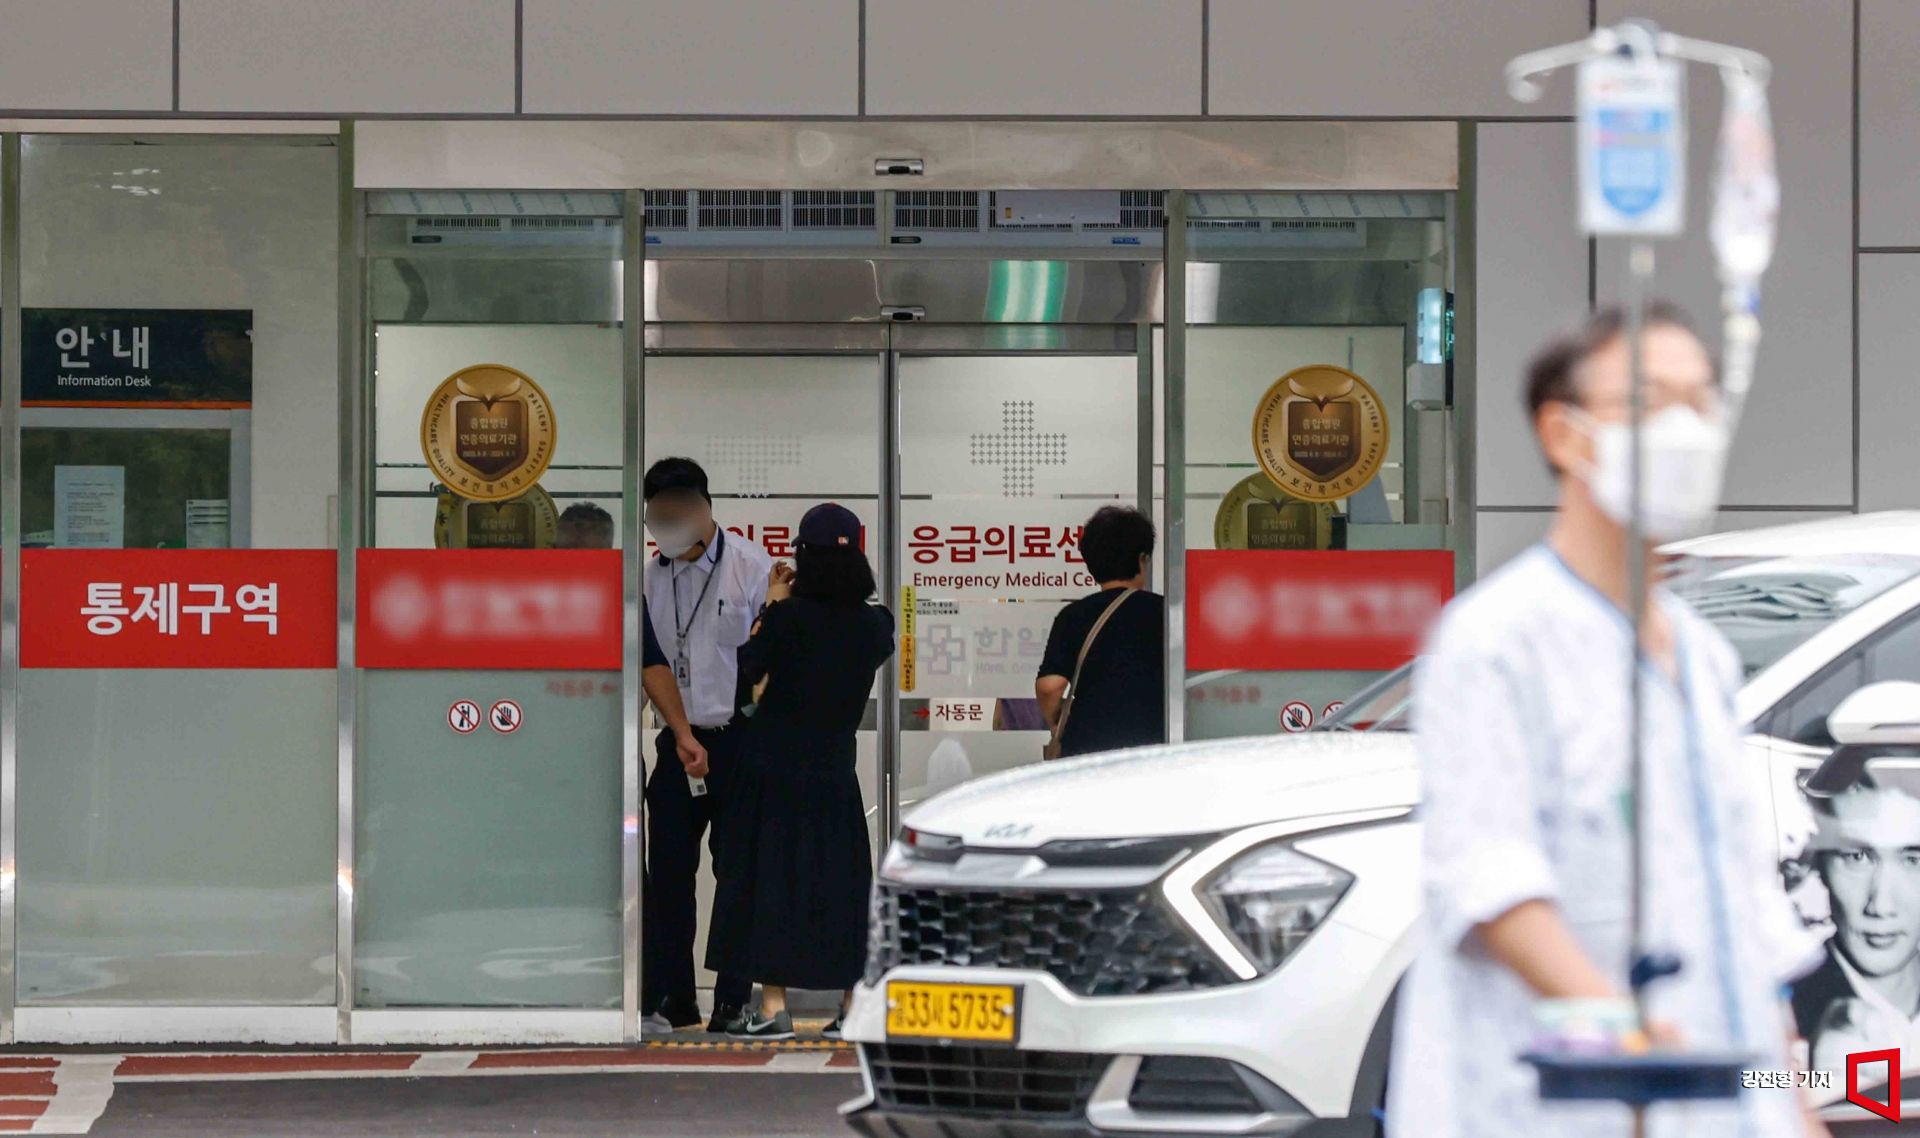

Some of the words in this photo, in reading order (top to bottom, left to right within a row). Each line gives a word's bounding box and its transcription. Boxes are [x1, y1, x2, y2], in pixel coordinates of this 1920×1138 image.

[57, 374, 123, 387] Information
[125, 375, 152, 387] Desk
[528, 393, 548, 433] PATIENT
[1361, 394, 1380, 433] PATIENT
[913, 572, 1000, 589] Emergency
[1006, 571, 1068, 587] Medical
[80, 582, 278, 635] 통제구역
[935, 703, 983, 721] 자동문
[949, 992, 1007, 1031] 5735
